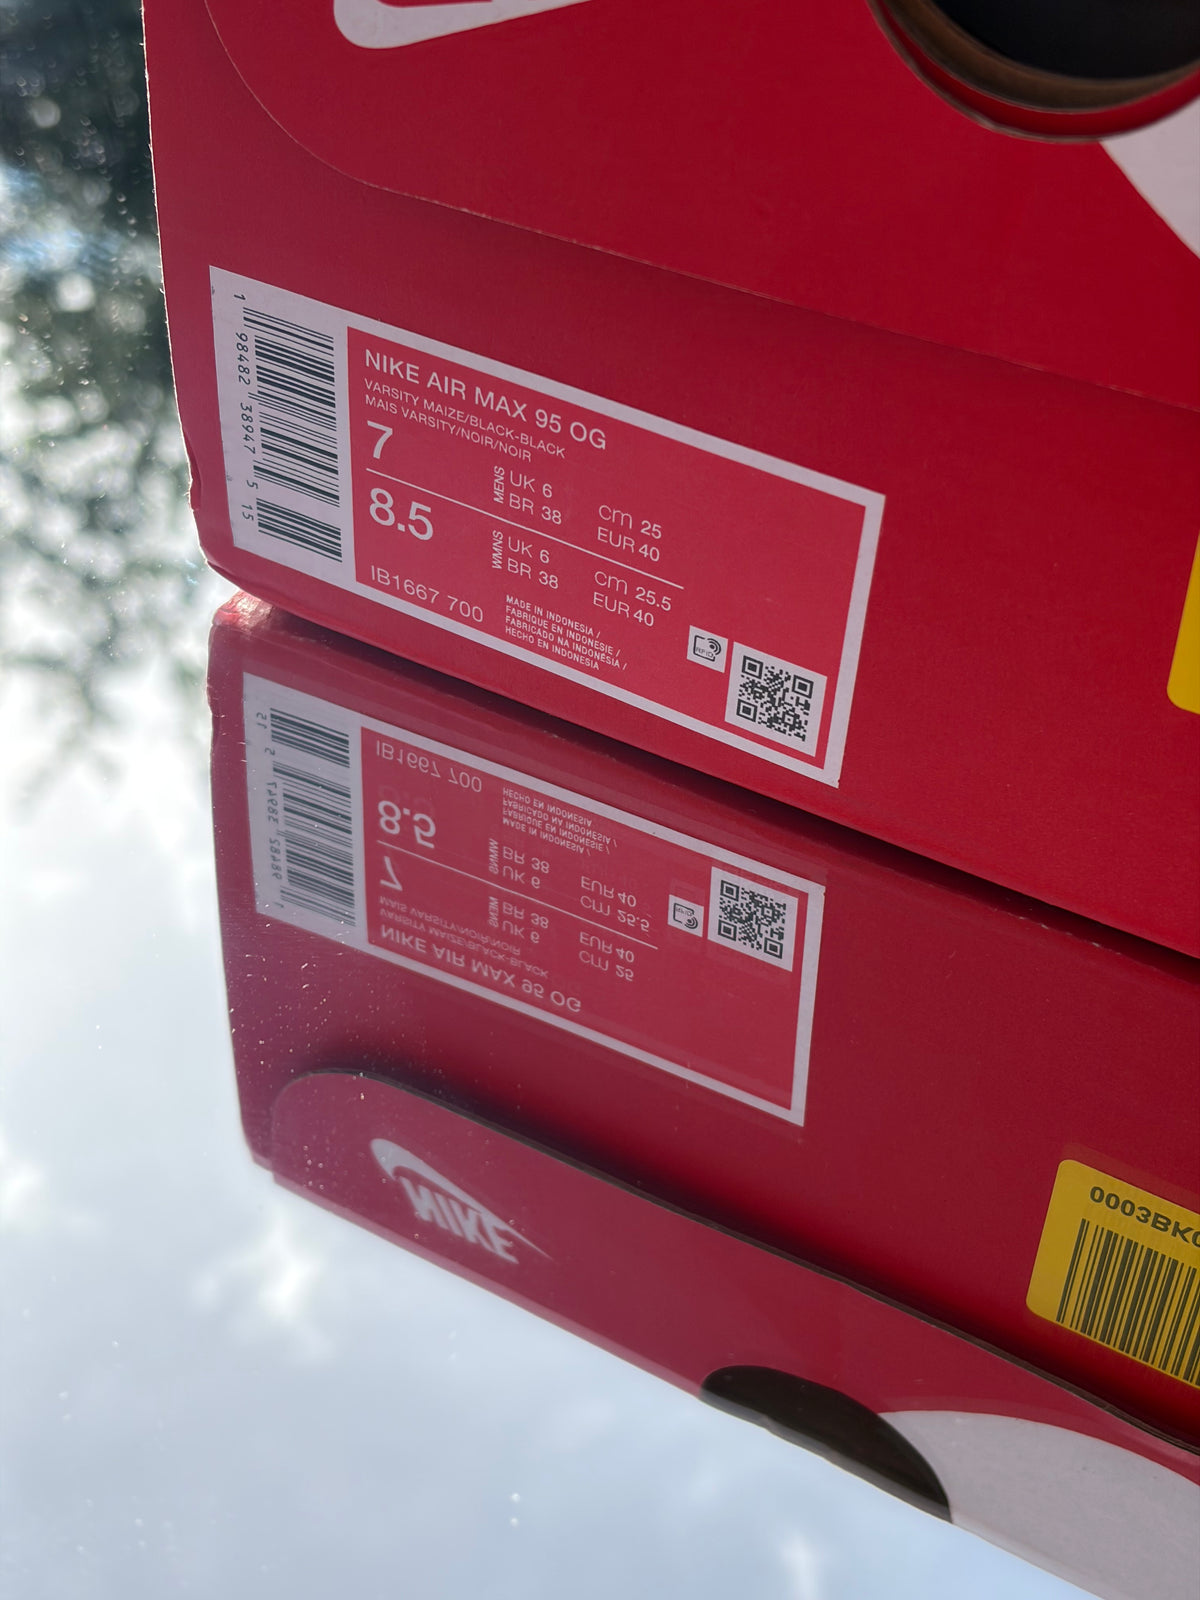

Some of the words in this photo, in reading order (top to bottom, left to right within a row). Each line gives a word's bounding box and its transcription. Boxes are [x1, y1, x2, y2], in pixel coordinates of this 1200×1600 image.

[235, 332, 251, 386] 98482
[365, 348, 420, 385] NIKE
[427, 371, 466, 401] AIR
[475, 386, 527, 422] MAX
[535, 408, 562, 434] 95
[569, 421, 606, 450] OG
[240, 402, 256, 455] 38947
[364, 377, 420, 407] VARSITY
[423, 398, 566, 459] MAIZE/BLACK-BLACK
[365, 394, 398, 414] MAIS
[401, 406, 532, 463] VARSITY/NOIR/NOIR
[367, 420, 393, 459] 7
[246, 479, 259, 490] 5
[493, 465, 505, 504] MENS
[510, 470, 536, 493] UK
[542, 483, 553, 498] 6
[241, 503, 254, 521] 15
[369, 487, 434, 541] 8.5
[509, 492, 534, 515] BR
[541, 505, 562, 525] 38
[597, 526, 636, 553] EUR
[638, 543, 660, 562] 40
[640, 520, 662, 539] 25
[491, 529, 504, 570] WMNS
[508, 536, 533, 559] UK
[539, 549, 550, 564] 6
[507, 557, 532, 580] BR
[538, 571, 559, 590] 38
[371, 564, 440, 604] IB1667
[447, 594, 484, 623] 700
[593, 591, 630, 619] EUR
[633, 609, 655, 627] 40
[635, 586, 672, 612] 25.5
[505, 605, 549, 630] FABRIQUE
[551, 622, 563, 635] EN
[505, 615, 554, 642] FABRICADO
[557, 636, 570, 648] NA
[506, 594, 532, 612] MADE
[534, 605, 543, 617] IN
[546, 610, 594, 637] INDONESIA
[505, 625, 535, 644] HECHO
[537, 638, 549, 650] EN
[551, 644, 600, 671] INDONESIA
